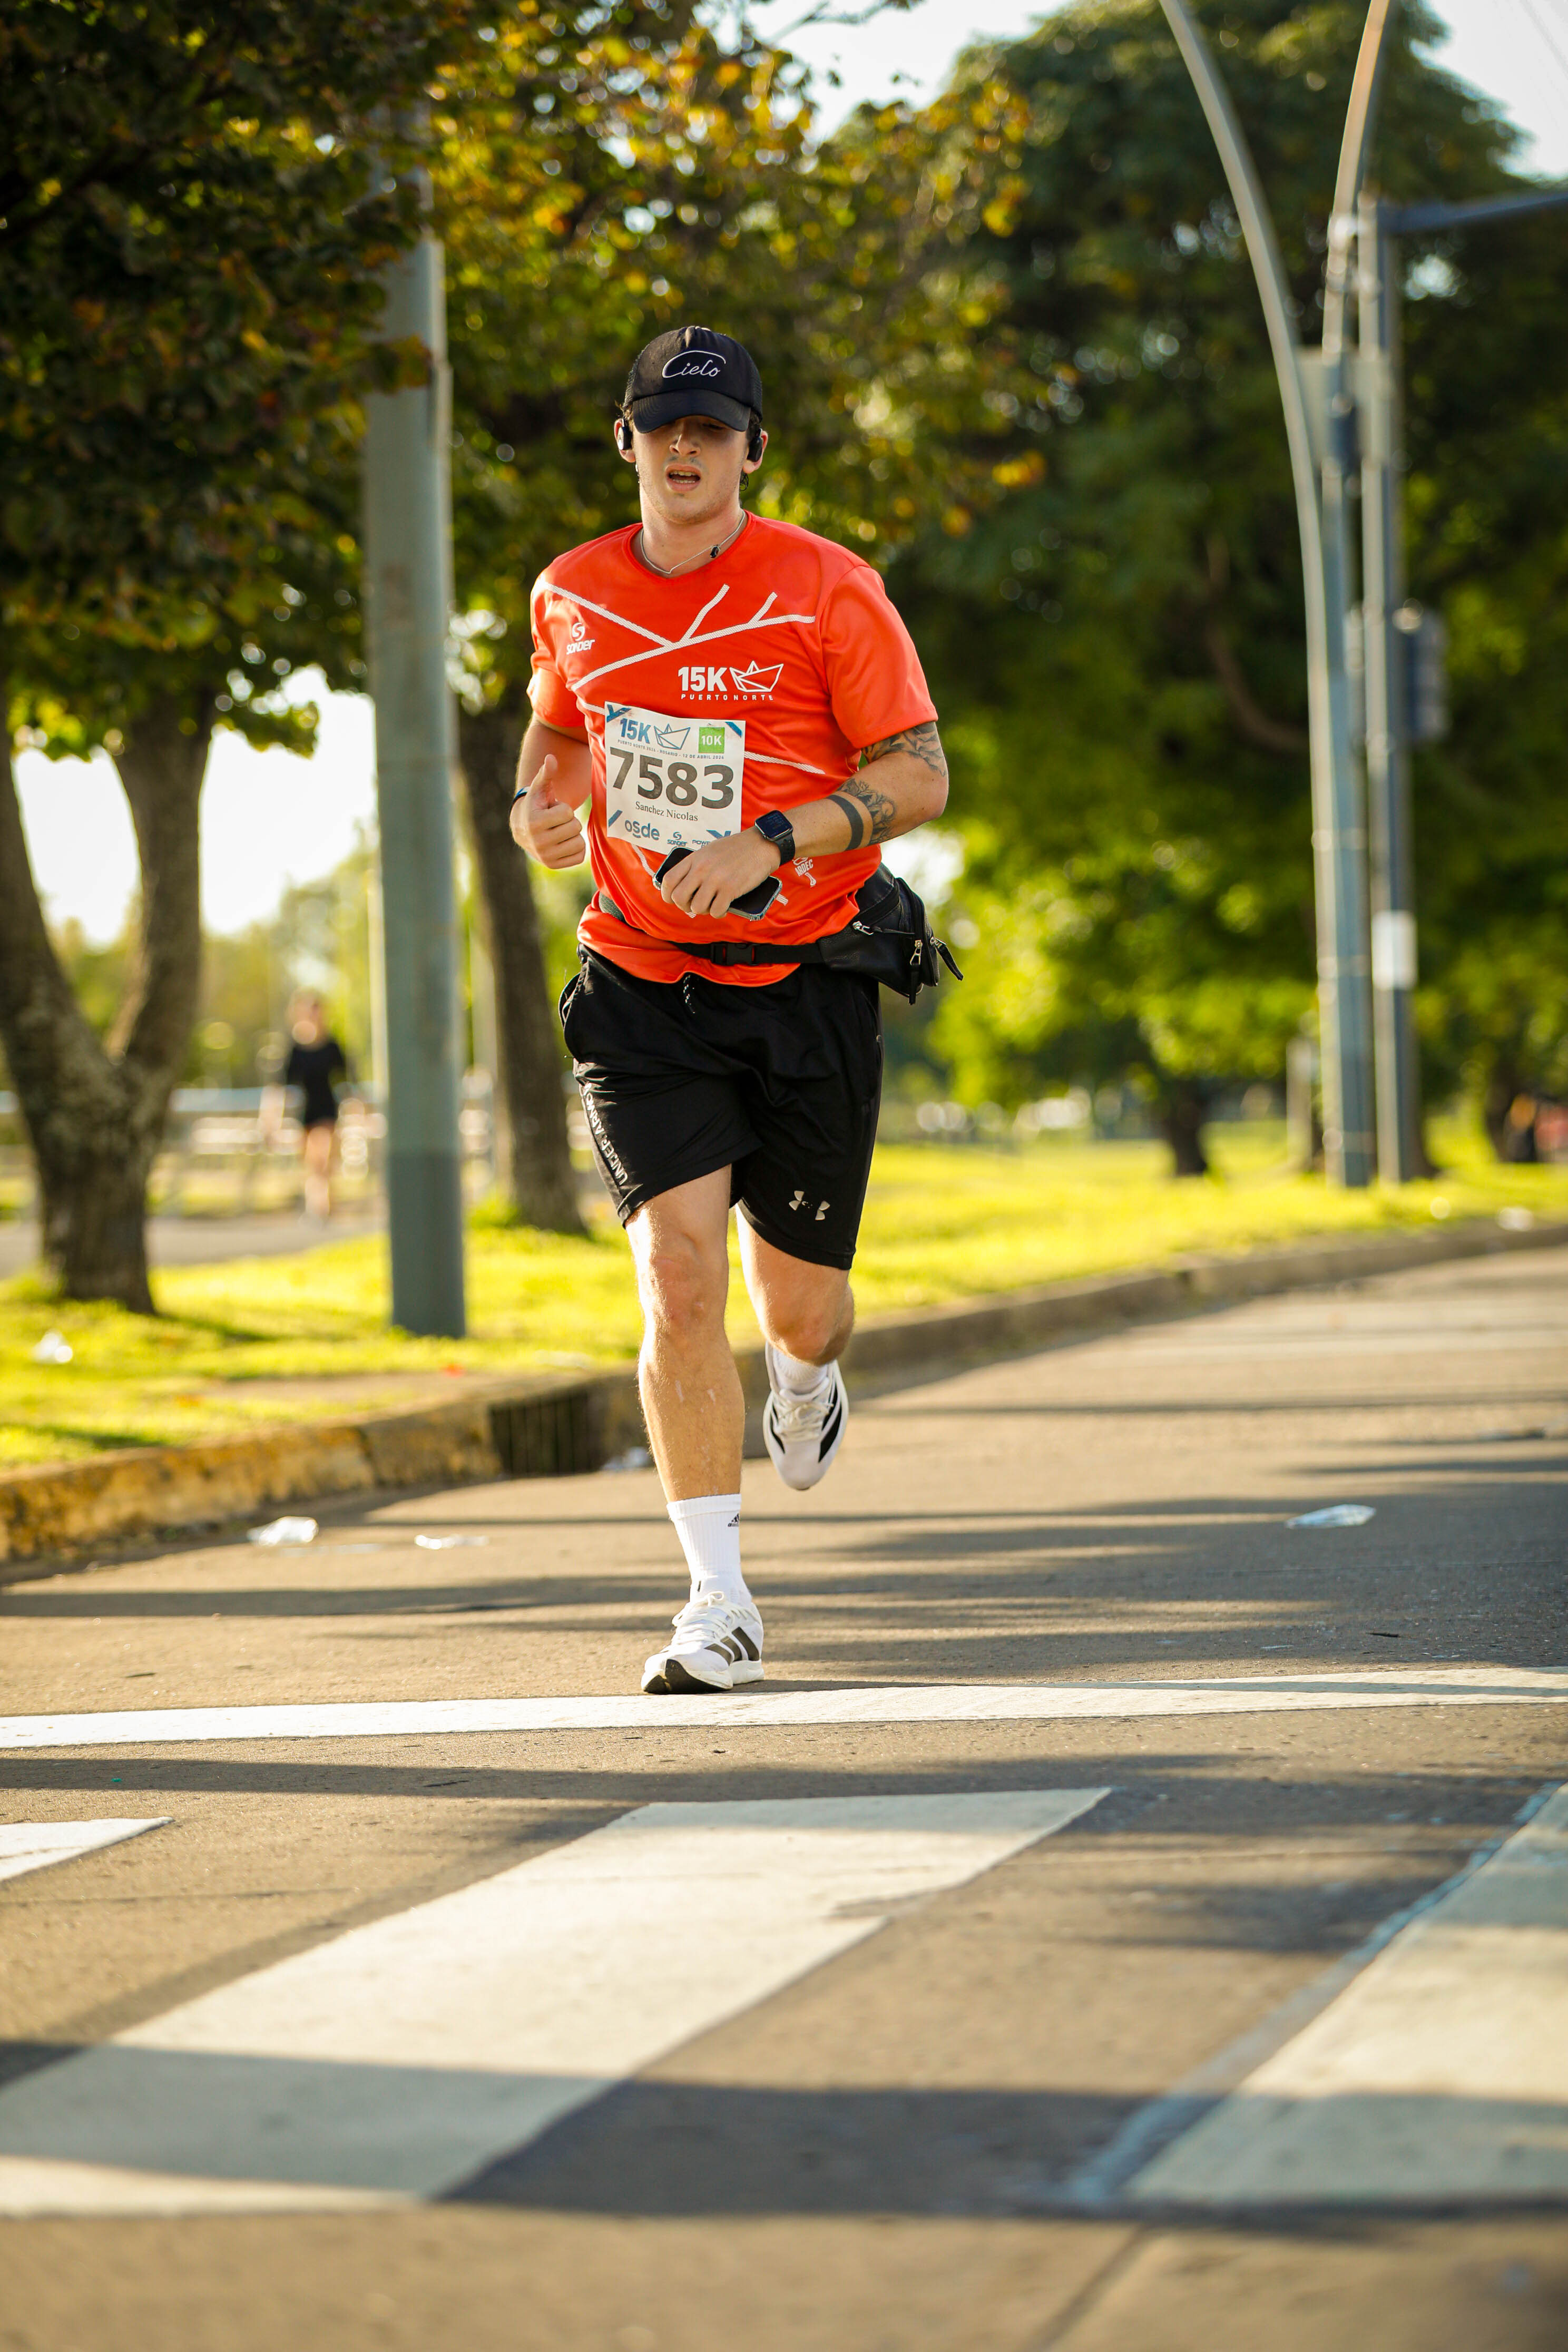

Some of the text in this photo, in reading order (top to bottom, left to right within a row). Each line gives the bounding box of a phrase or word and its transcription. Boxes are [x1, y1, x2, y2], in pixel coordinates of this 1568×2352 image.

[662, 350, 726, 378] Cielo
[678, 667, 728, 692] 15K
[620, 718, 651, 744] 15K
[701, 735, 722, 746] 10K
[610, 747, 734, 809] 7583
[635, 801, 699, 821] Sanchez Nicolas
[625, 820, 660, 841] osde
[601, 1135, 628, 1185] UNDER
